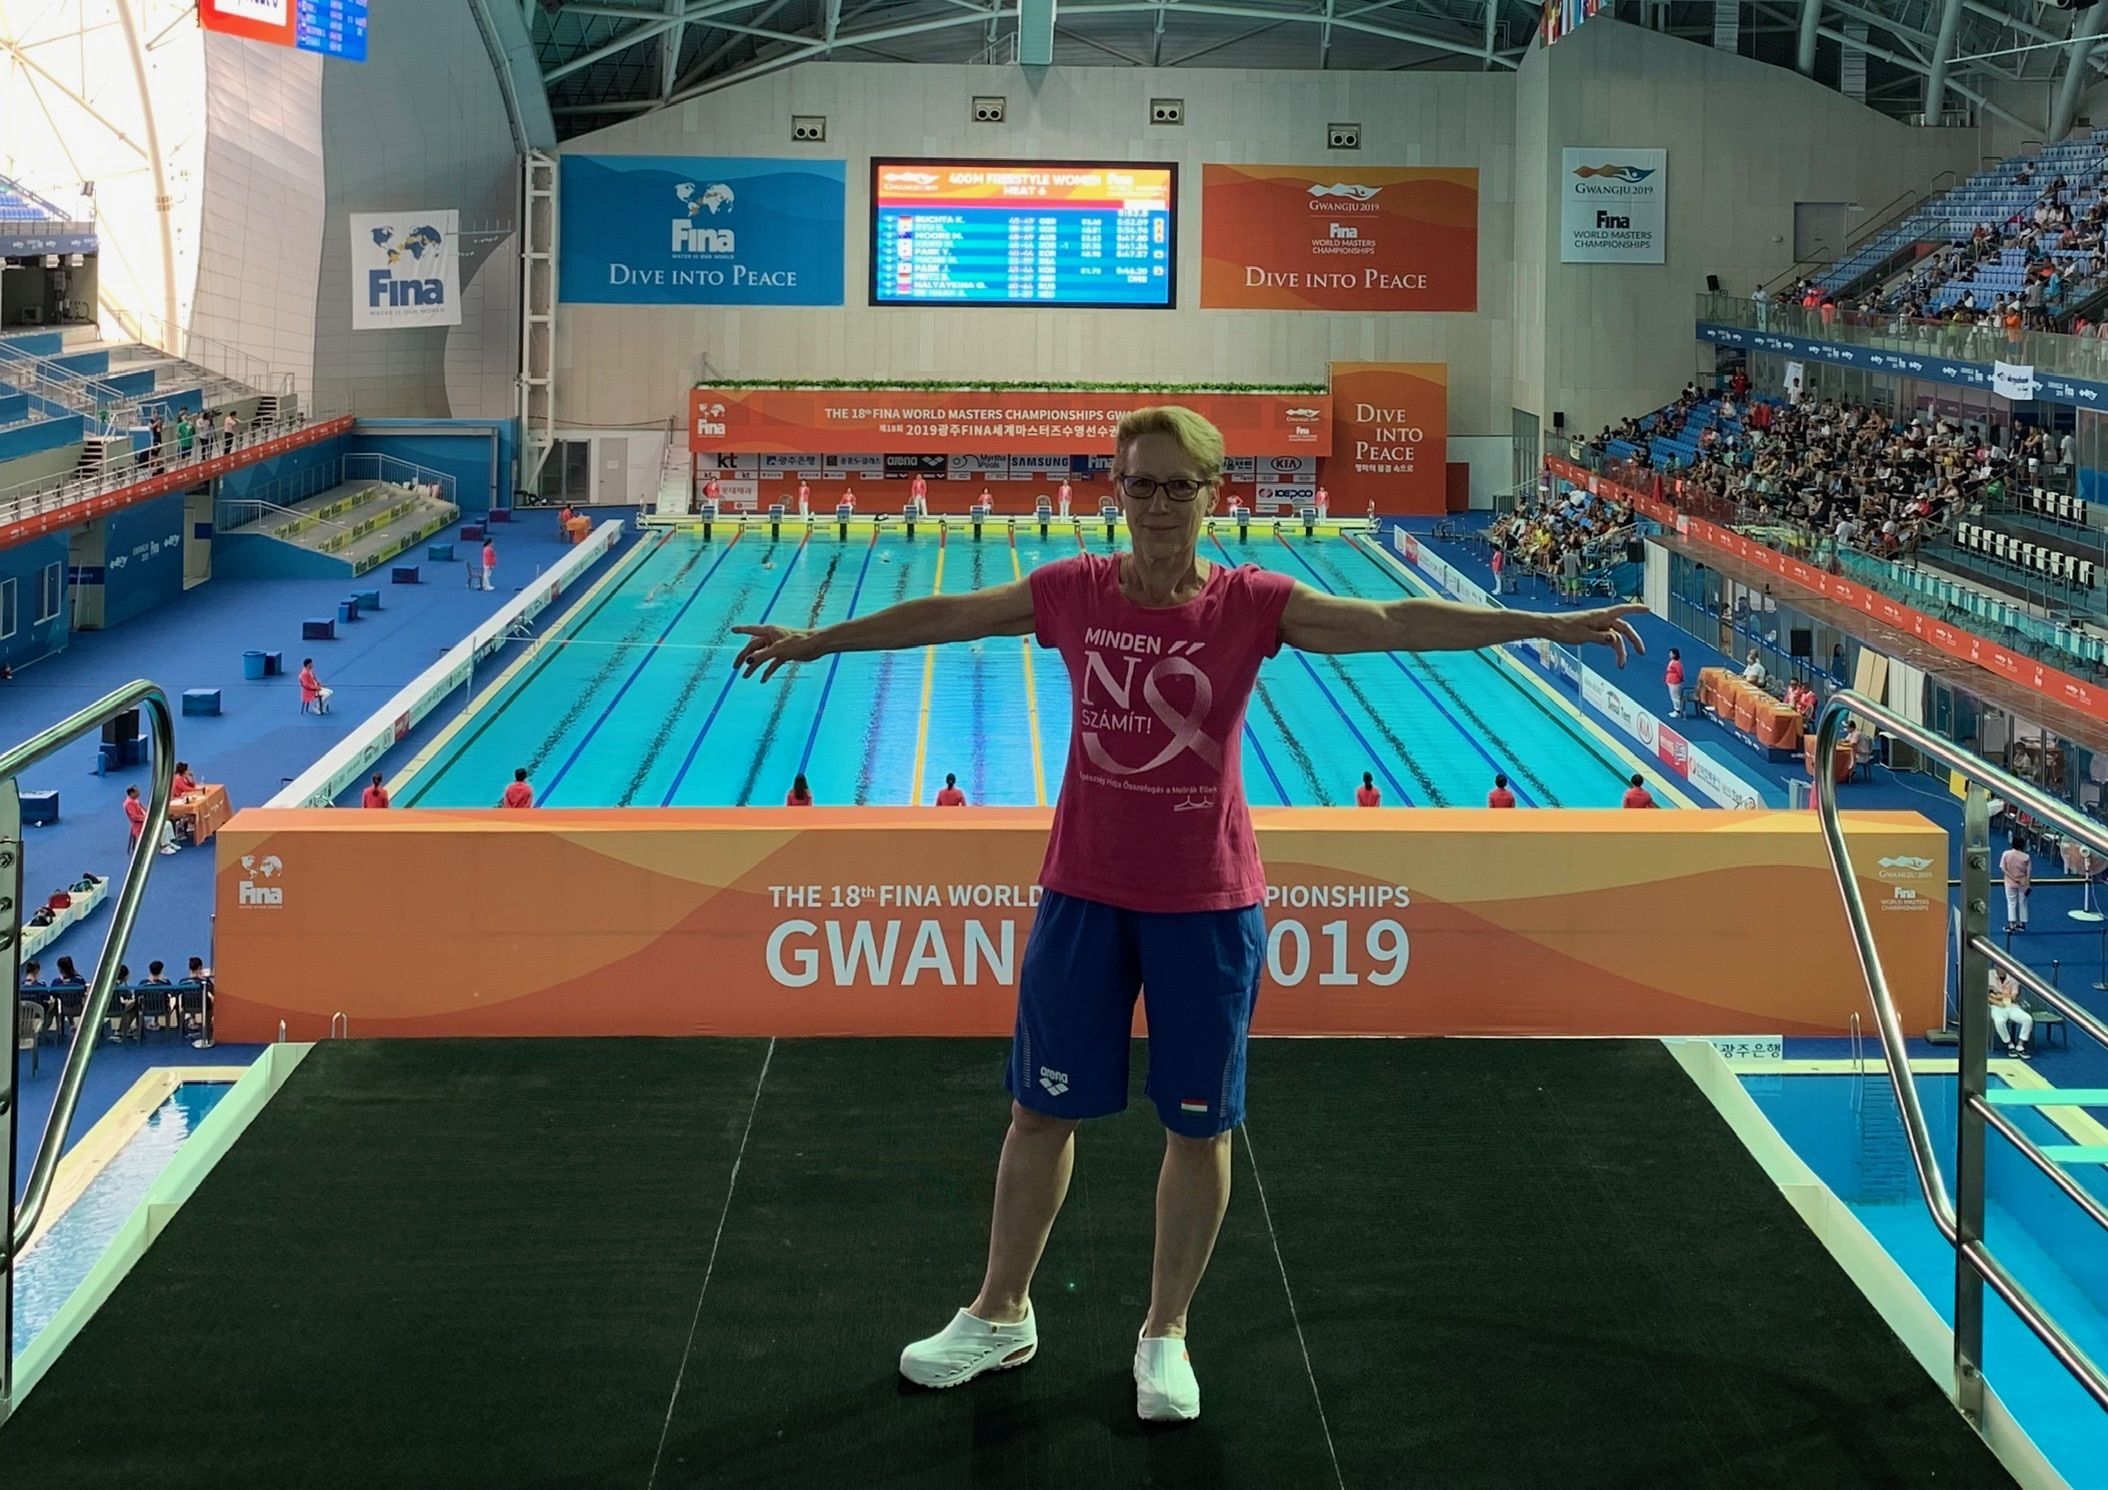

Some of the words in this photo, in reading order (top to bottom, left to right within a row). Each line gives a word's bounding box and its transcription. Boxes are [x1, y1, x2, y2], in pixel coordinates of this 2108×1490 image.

[1632, 186, 1654, 195] 2019
[1360, 203, 1380, 211] 2019
[1573, 231, 1608, 239] WORLD
[1611, 231, 1652, 240] MASTERS
[1574, 240, 1651, 249] CHAMPIONSHIPS
[1312, 246, 1375, 254] CHAMPIONSHIPS
[825, 408, 849, 419] THE
[873, 408, 900, 419] FINA
[902, 409, 946, 420] WORLD
[949, 409, 1003, 420] MASTERS
[1005, 409, 1104, 421] CHAMPIONSHIPS
[717, 452, 738, 468] kt
[887, 457, 918, 466] arena
[980, 454, 1007, 463] Myrtha
[1011, 457, 1069, 467] SAMSUNG
[980, 461, 1000, 469] Pools
[1276, 459, 1297, 468] KIA
[1085, 627, 1161, 655] MINDEN
[1081, 708, 1152, 734] SZÁMÍT!
[768, 885, 822, 907] THE
[879, 885, 942, 907] FINA
[948, 885, 1044, 907] WORLD
[1264, 885, 1410, 908] PIONSHIPS
[1266, 918, 1410, 987] 019
[1720, 1043, 1781, 1059] 광주은행
[1040, 1065, 1068, 1085] arena
